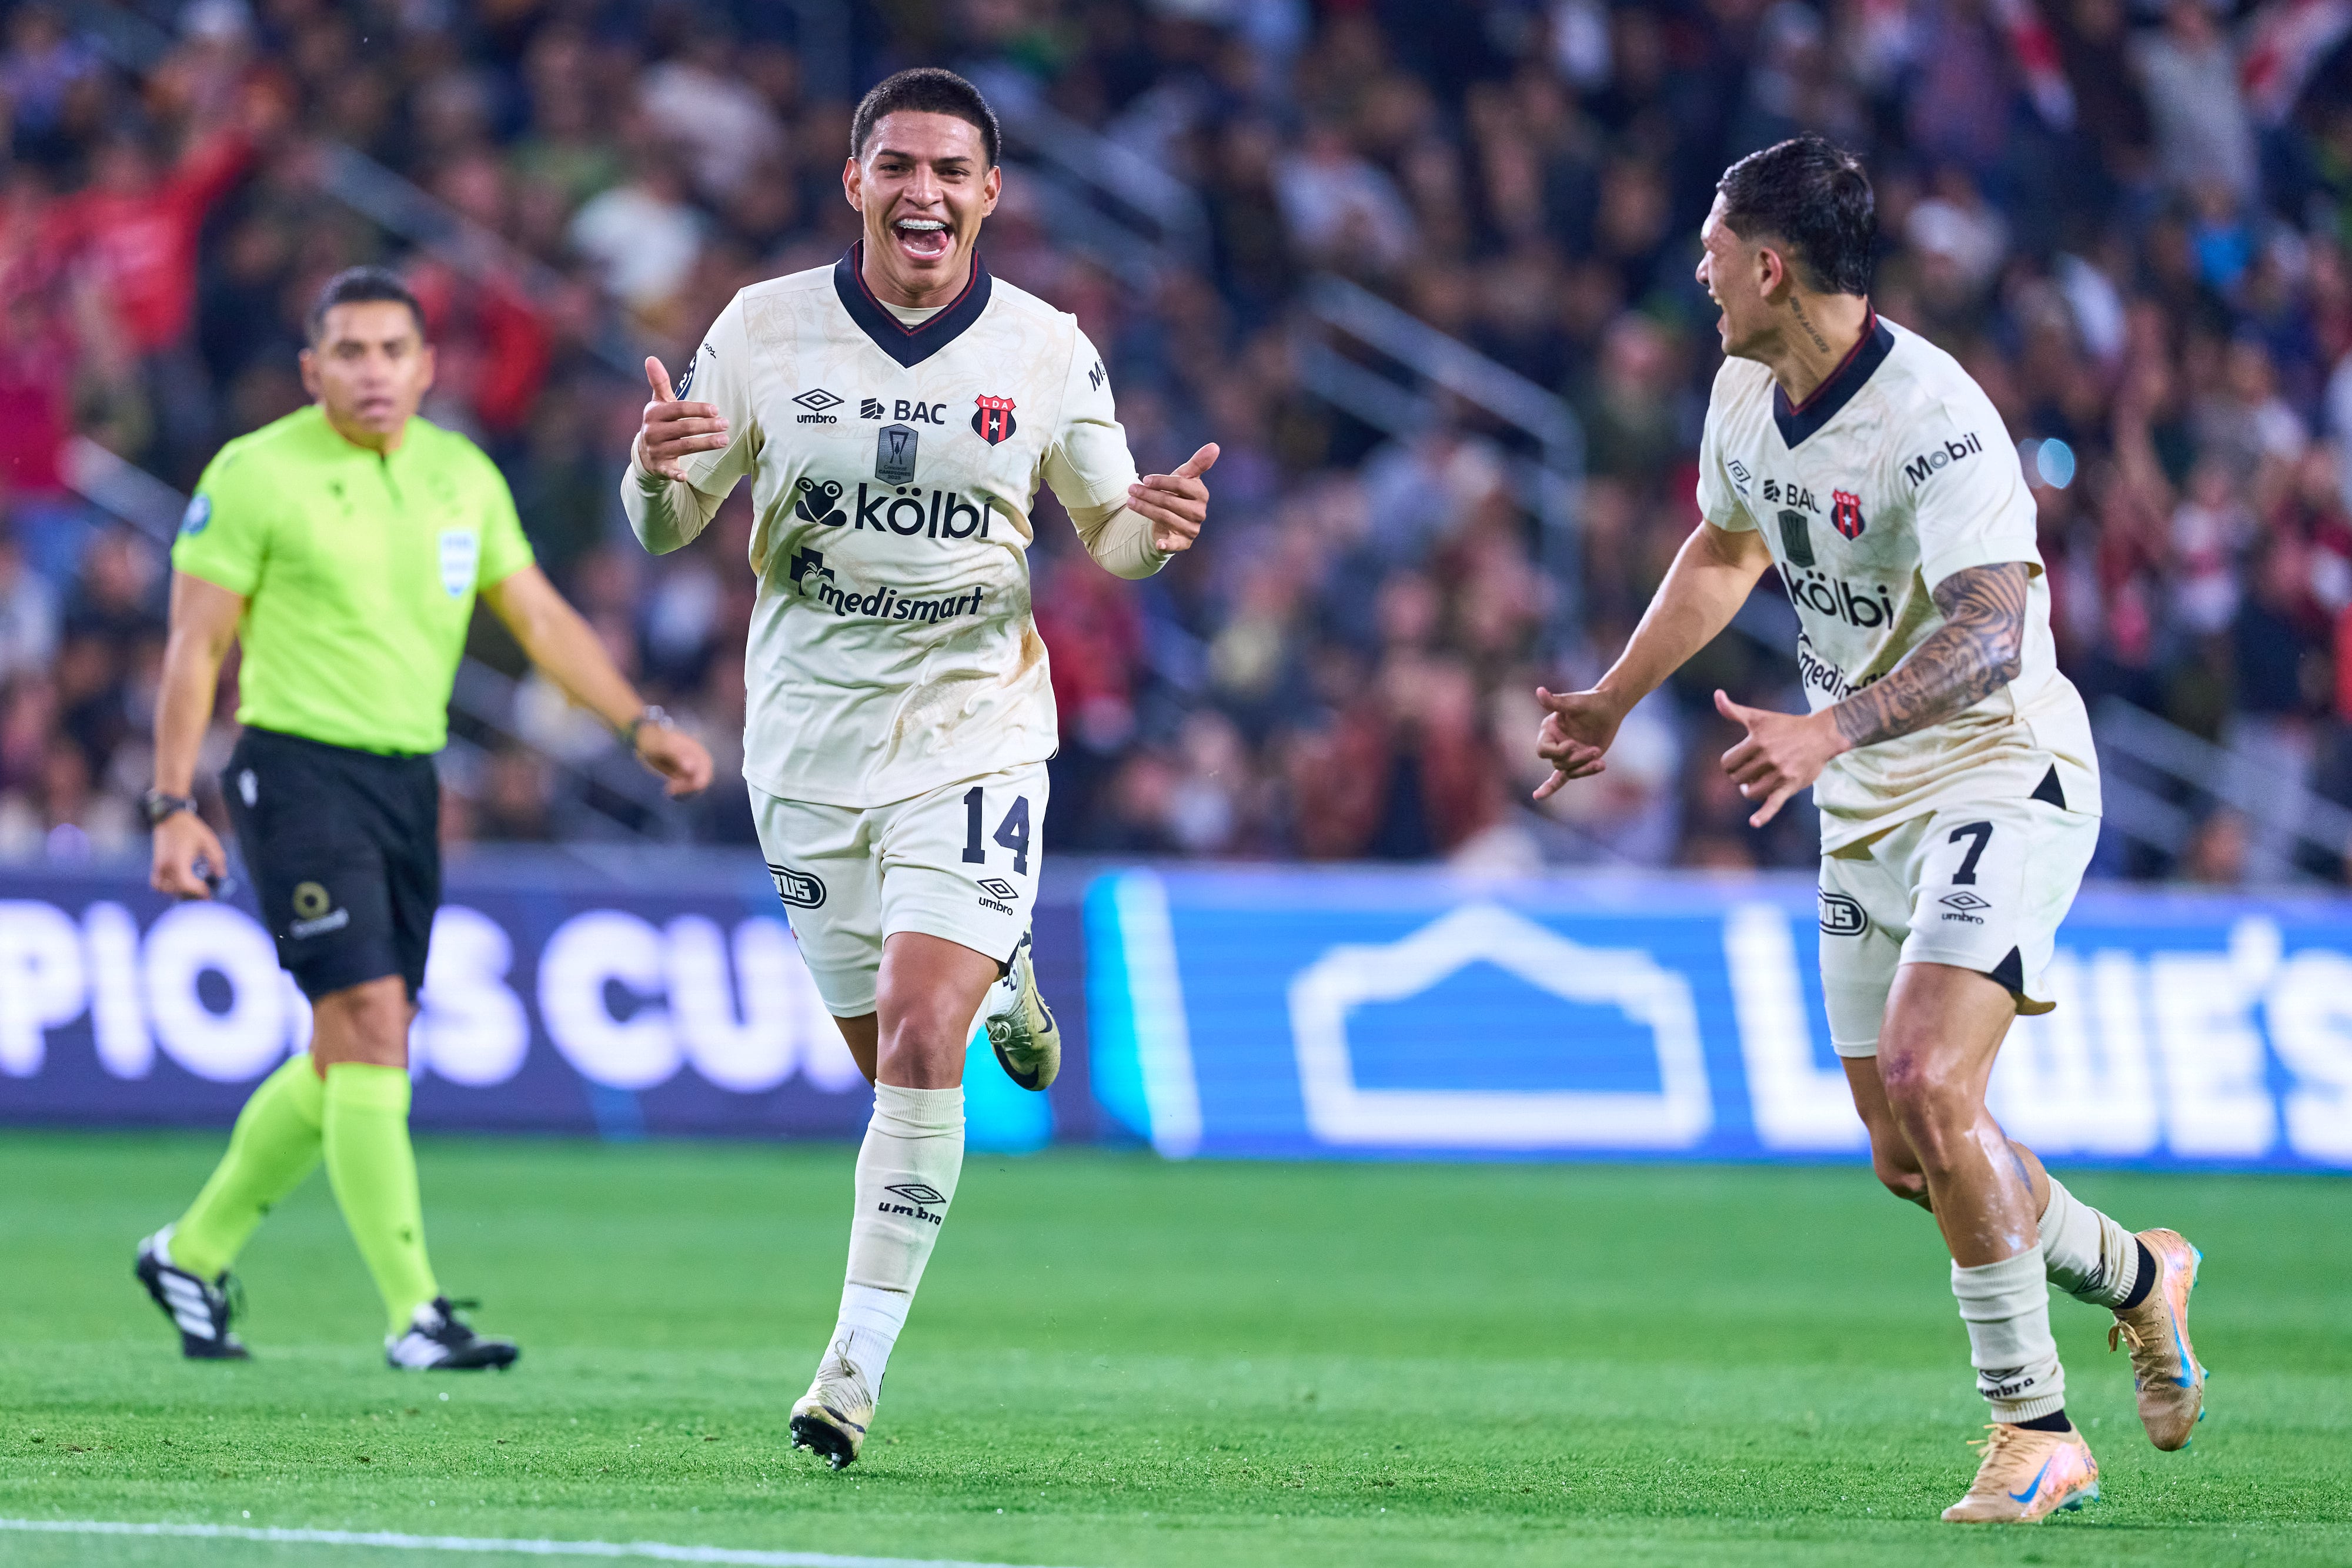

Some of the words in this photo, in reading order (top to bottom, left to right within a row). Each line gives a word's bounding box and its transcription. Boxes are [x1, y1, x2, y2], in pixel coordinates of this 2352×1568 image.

[797, 413, 837, 424] umbro
[894, 400, 947, 425] BAC
[983, 399, 1008, 410] LDA
[1905, 432, 1983, 487] Mobil
[855, 483, 996, 539] kölbi
[818, 583, 984, 624] medismart
[1782, 562, 1893, 630] kölbi
[961, 786, 1031, 877] 14
[1948, 821, 1993, 885] 7
[978, 897, 1013, 916] umbro
[1942, 912, 1984, 925] umbro
[0, 900, 530, 1089] PIOS
[1723, 905, 2352, 1157] LWE'S
[878, 1202, 942, 1225] umbro
